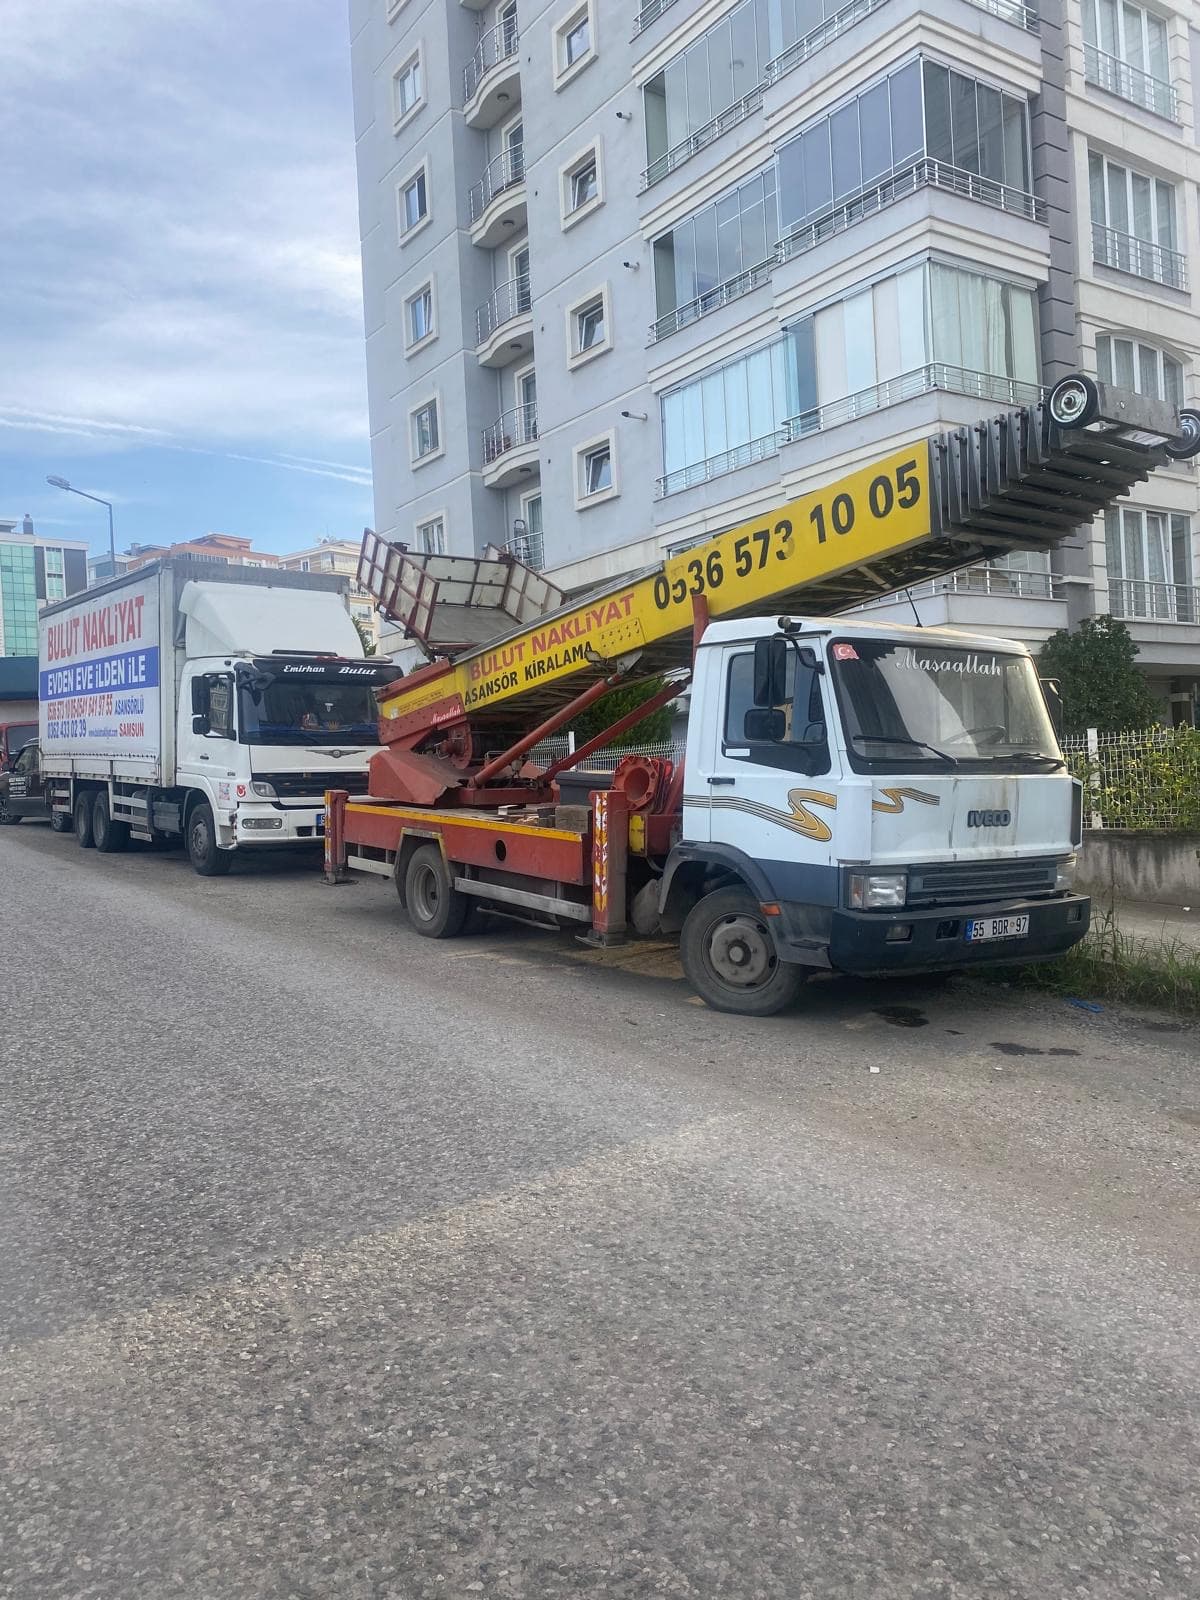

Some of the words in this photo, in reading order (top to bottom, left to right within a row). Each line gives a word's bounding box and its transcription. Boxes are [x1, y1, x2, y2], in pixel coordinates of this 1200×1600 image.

[734, 519, 794, 578] 573
[809, 492, 856, 544] 10
[868, 459, 921, 519] 05
[47, 617, 80, 662] BULUT
[283, 664, 325, 673] Emirhan
[338, 666, 377, 675] Bulut
[470, 641, 526, 682] BULUT
[48, 669, 74, 696] EVDEN
[76, 666, 93, 691] EVE
[464, 670, 519, 706] ASANSÖR
[106, 693, 112, 716] 55
[48, 721, 59, 739] 0362
[60, 720, 70, 738] 433
[71, 719, 78, 738] 02
[79, 718, 87, 737] 39
[119, 722, 144, 737] SAMSUN
[967, 809, 1011, 828] IVECO
[973, 922, 985, 937] 55
[992, 919, 1009, 935] BDR
[1015, 917, 1027, 932] 97
